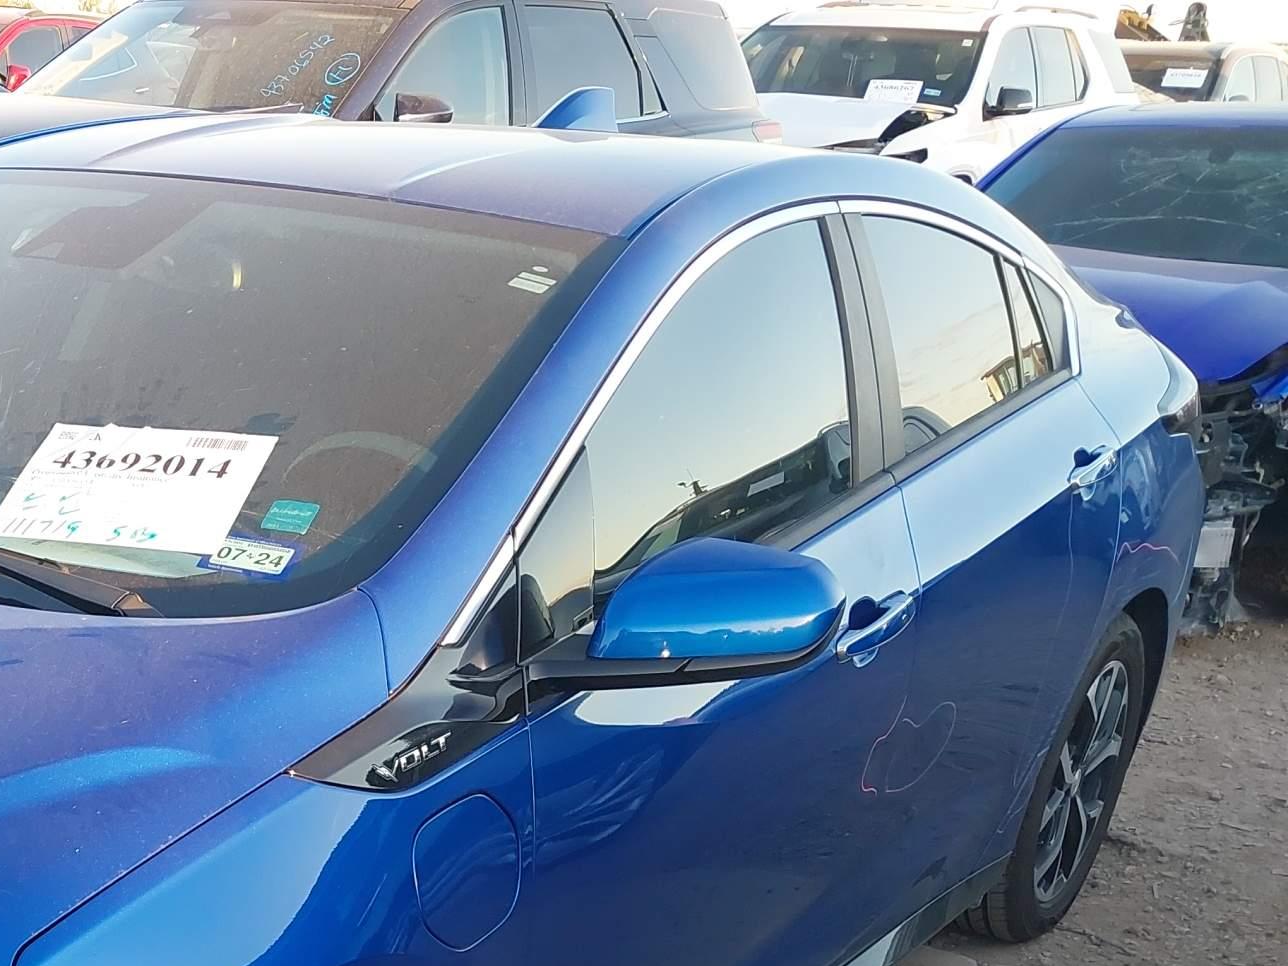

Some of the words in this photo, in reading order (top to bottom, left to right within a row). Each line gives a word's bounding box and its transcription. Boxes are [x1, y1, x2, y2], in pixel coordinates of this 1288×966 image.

[52, 449, 232, 479] 43692014
[216, 546, 248, 561] 07
[253, 552, 284, 568] 24
[371, 730, 452, 783] VOLT
